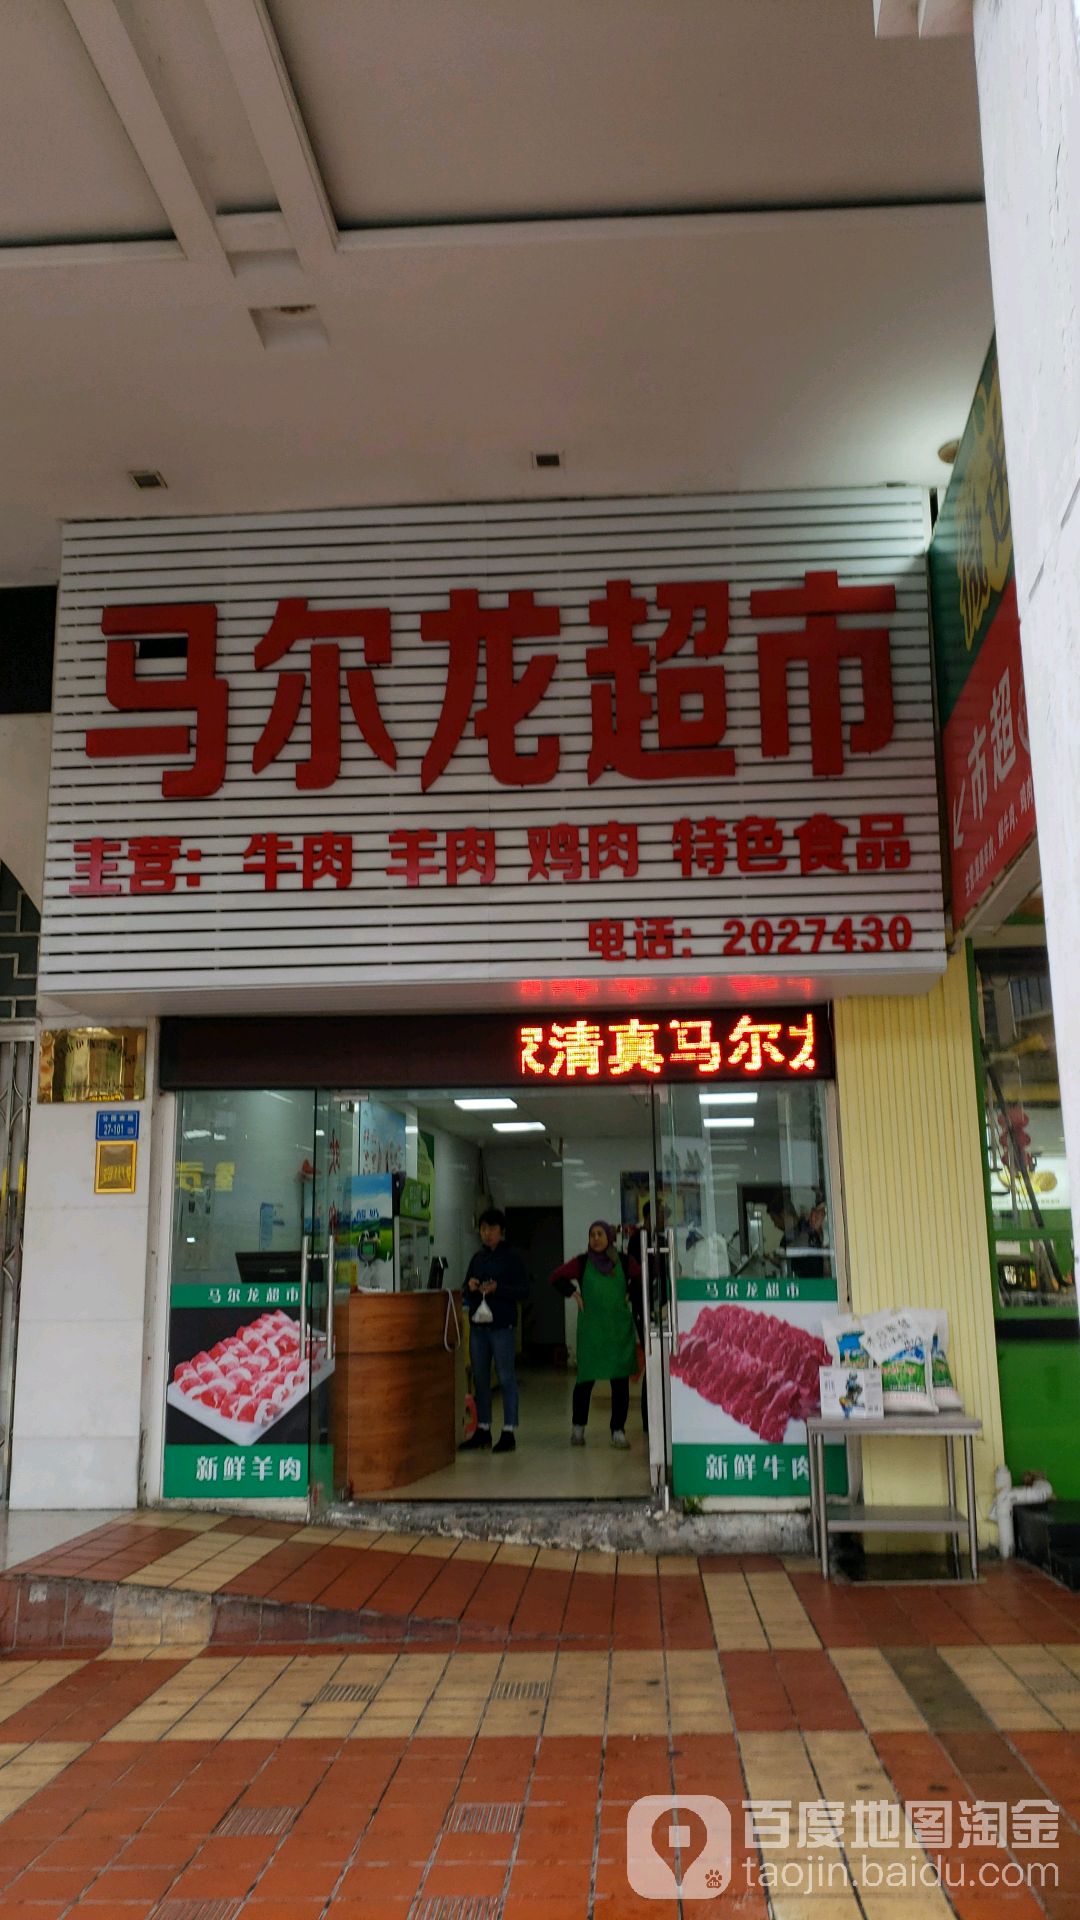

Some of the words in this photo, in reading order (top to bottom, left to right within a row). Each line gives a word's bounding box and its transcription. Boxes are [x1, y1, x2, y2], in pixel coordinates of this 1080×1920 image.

[85, 571, 895, 798] 马尔龙超市
[243, 832, 353, 890] 牛肉
[385, 827, 497, 887] 羊肉
[527, 820, 640, 880] 鸡肉
[671, 812, 912, 877] 特色食品
[722, 914, 913, 957] 2027430
[208, 1287, 299, 1303] 马尔龙超市
[706, 1282, 799, 1298] 马尔龙超市
[196, 1455, 301, 1481] 新鲜羊肉
[706, 1454, 810, 1480] 新鲜牛肉
